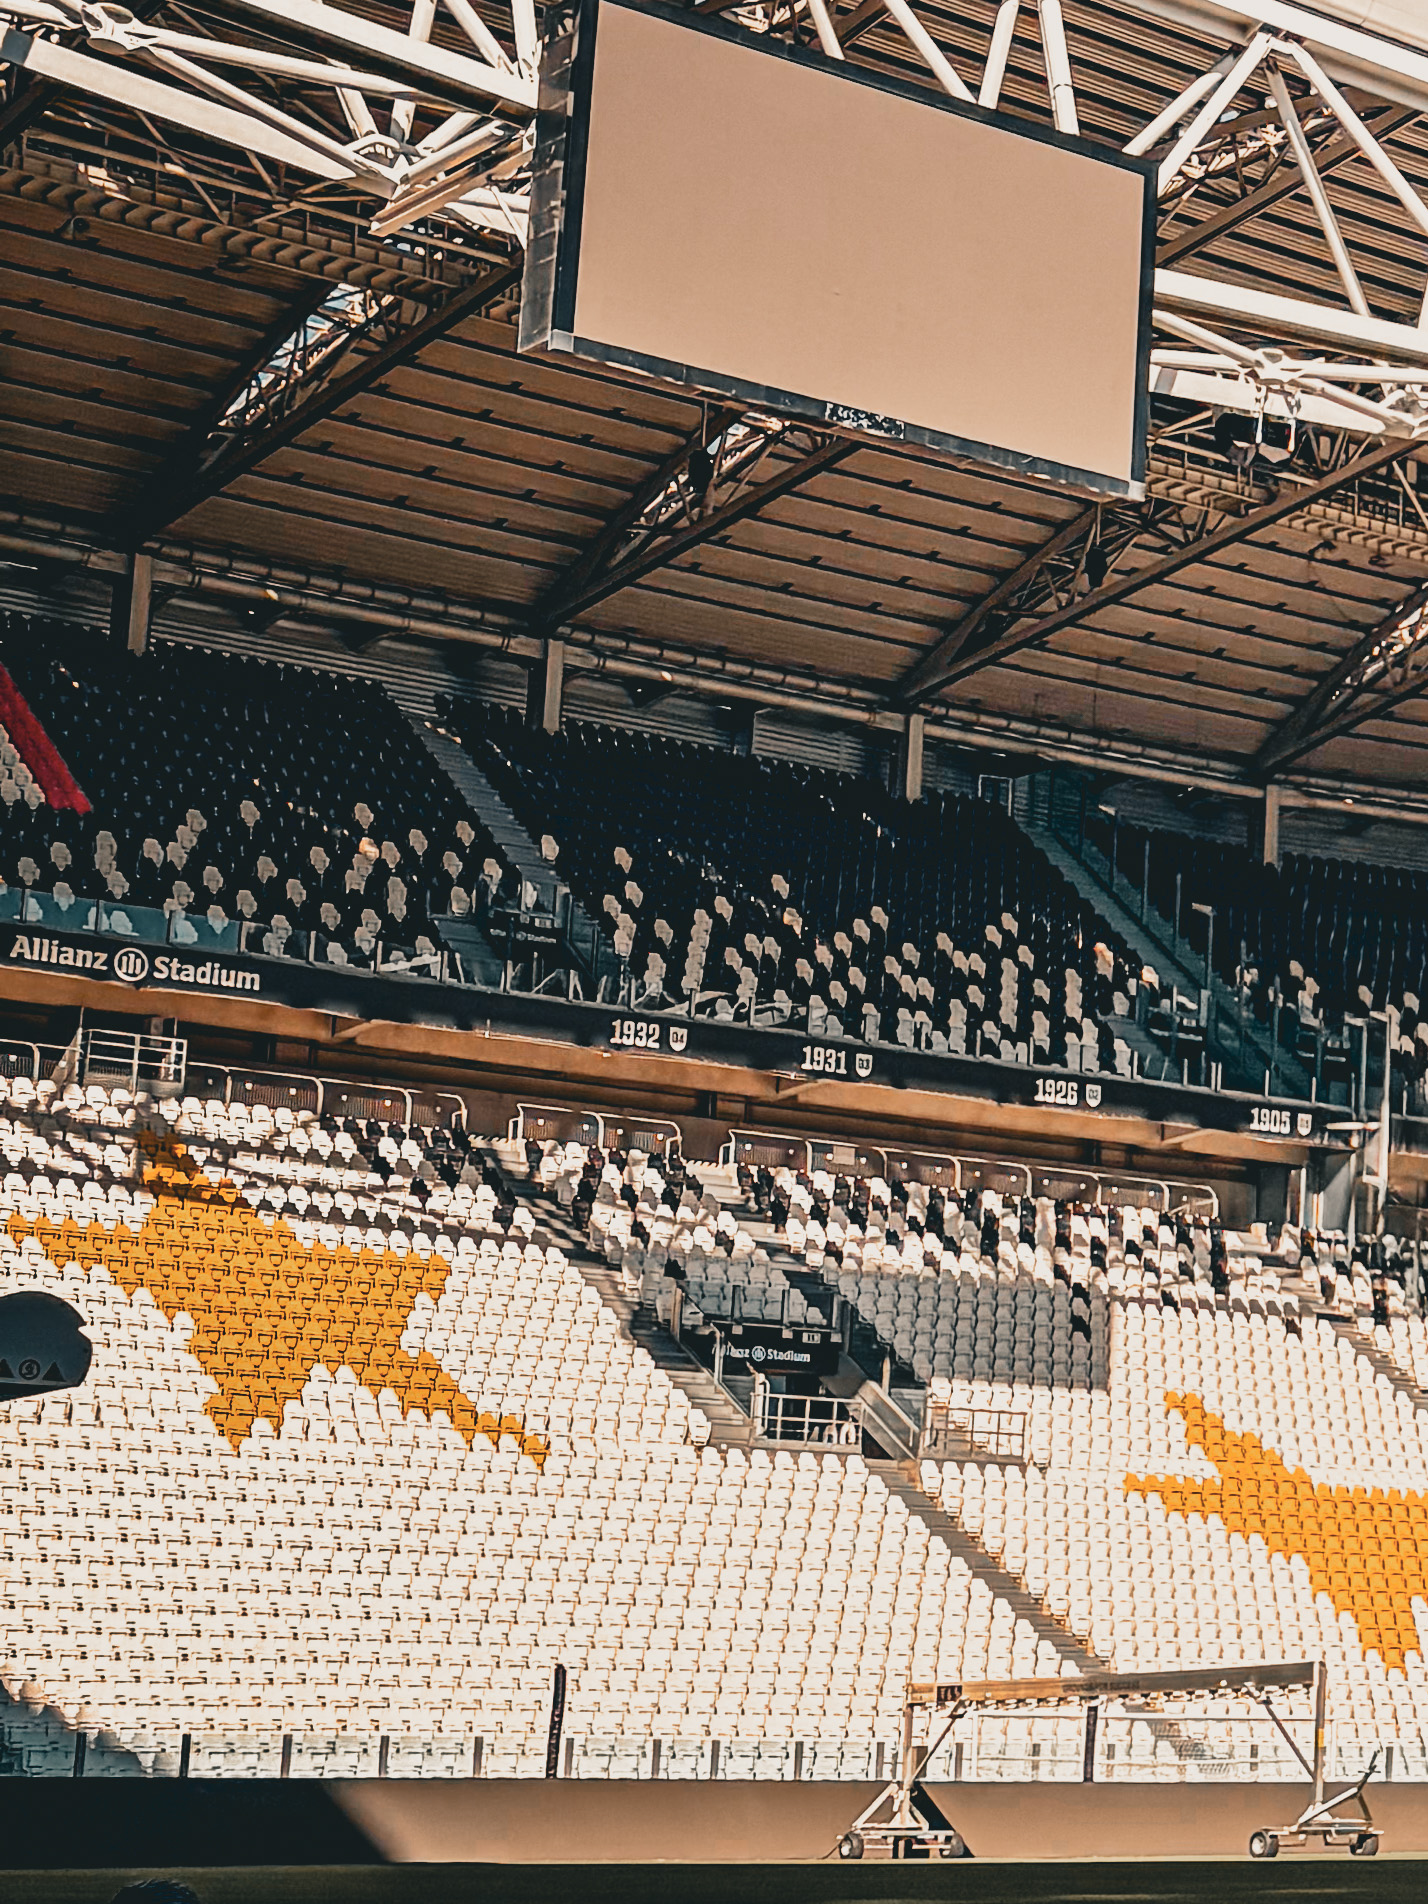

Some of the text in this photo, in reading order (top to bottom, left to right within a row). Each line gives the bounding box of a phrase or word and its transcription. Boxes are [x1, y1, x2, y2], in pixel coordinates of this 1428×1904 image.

[9, 934, 261, 991] Allianz Stadium
[610, 1018, 660, 1049] 1932
[800, 1045, 848, 1075] 1931
[1033, 1078, 1078, 1106] 1926
[1249, 1107, 1291, 1135] 1905
